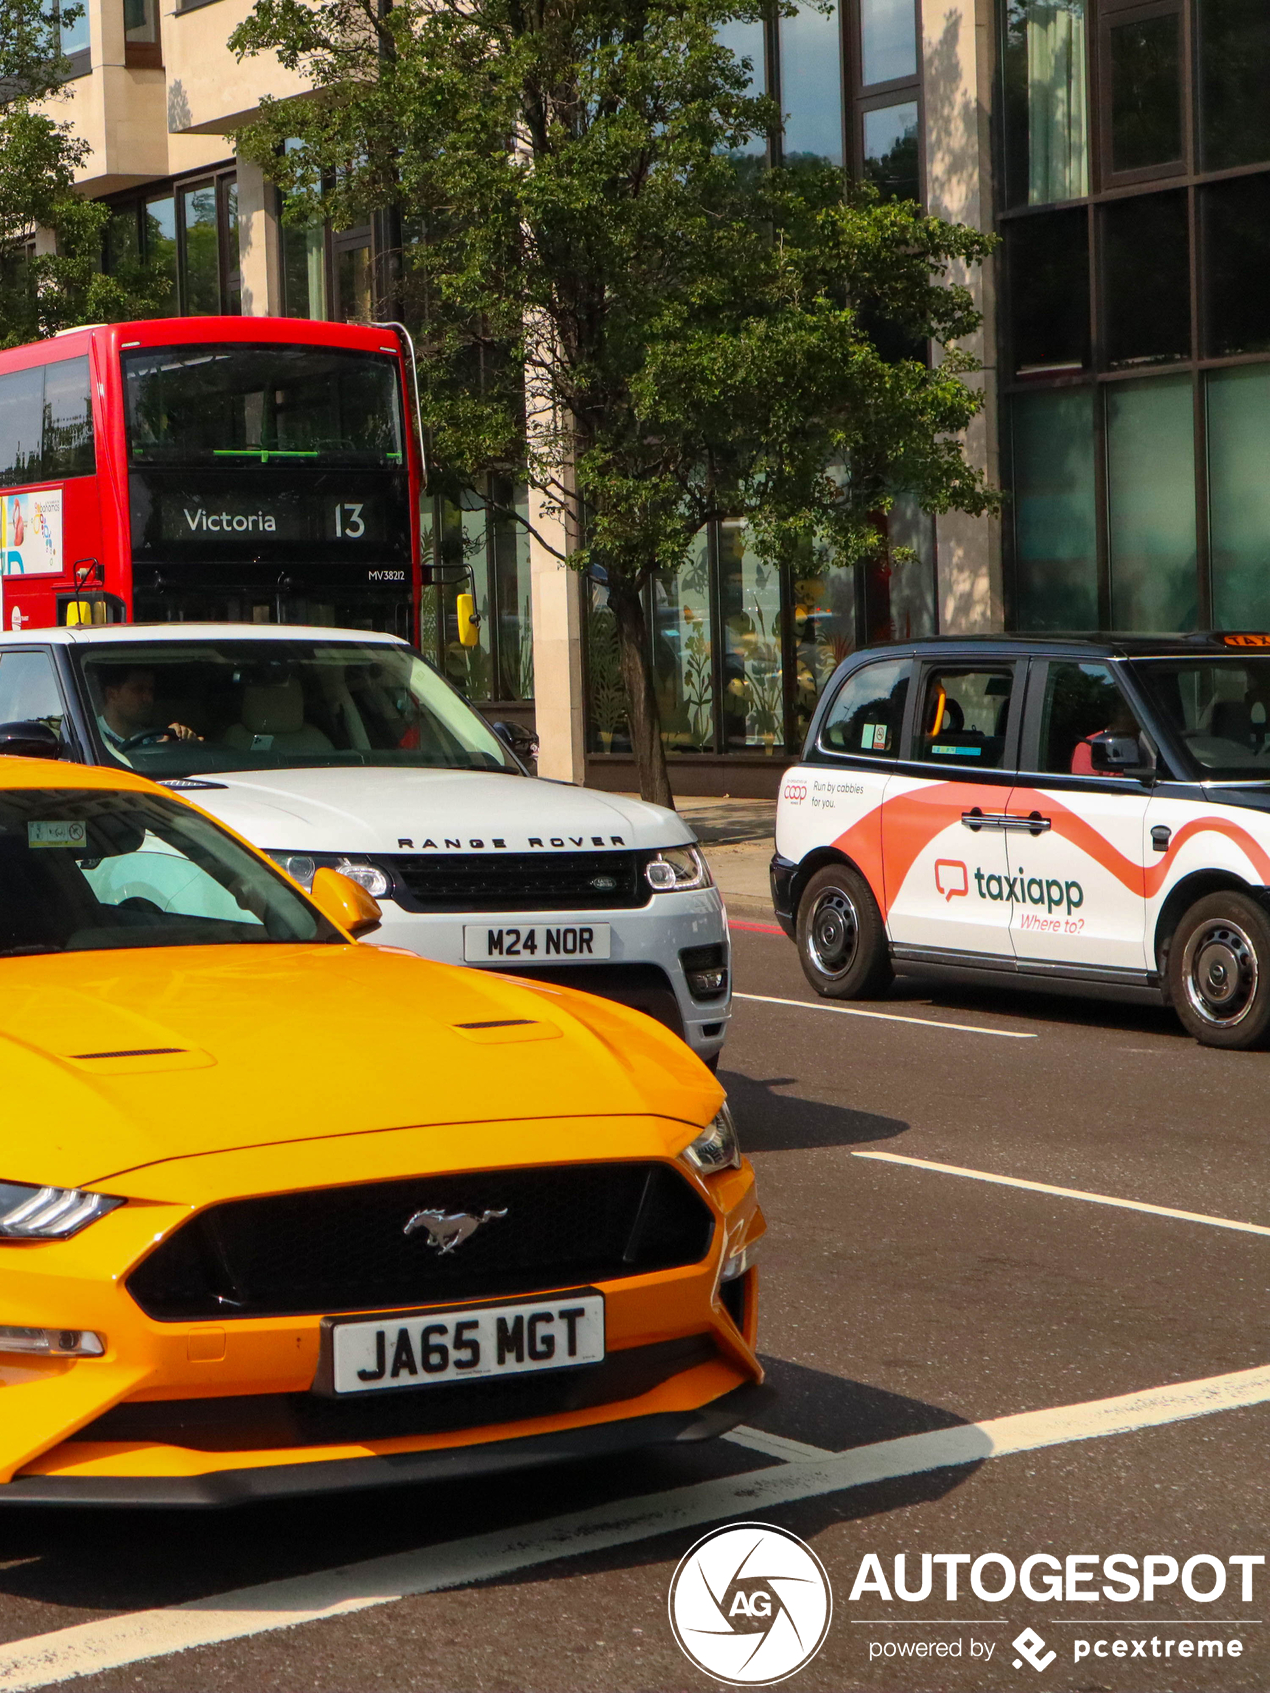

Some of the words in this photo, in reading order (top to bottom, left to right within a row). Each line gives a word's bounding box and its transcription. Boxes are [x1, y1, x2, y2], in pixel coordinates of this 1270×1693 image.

[183, 508, 276, 532] Victoria
[335, 502, 365, 538] 13
[368, 570, 405, 581] MV38212
[813, 780, 826, 792] Run
[827, 782, 836, 794] by
[837, 783, 864, 795] cabbies
[811, 796, 821, 807] for
[821, 799, 836, 809] you.
[397, 837, 507, 849] RANGE
[528, 836, 626, 848] ROVER
[974, 866, 1084, 916] taxiapp
[1020, 913, 1061, 932] Where
[1064, 918, 1085, 934] to?
[487, 928, 538, 956] M24
[545, 927, 594, 955] NOR
[356, 1319, 481, 1382] JA65
[496, 1307, 585, 1366] MGT
